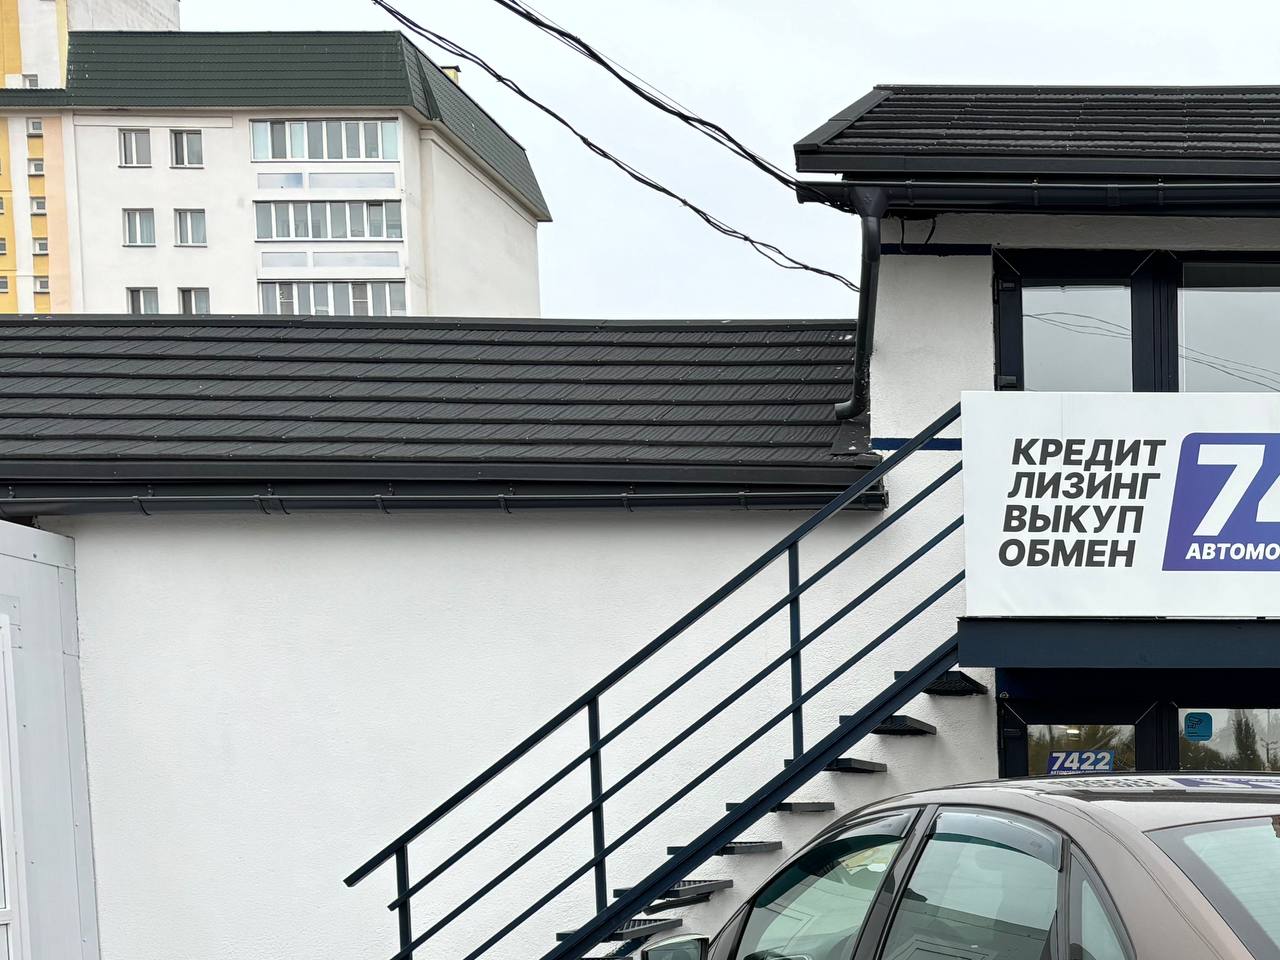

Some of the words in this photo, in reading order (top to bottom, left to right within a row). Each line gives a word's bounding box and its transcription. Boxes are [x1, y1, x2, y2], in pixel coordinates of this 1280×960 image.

[1011, 438, 1167, 470] КРЕДИТ
[1006, 472, 1161, 500] ЛИЗИНГ
[1002, 505, 1145, 533] ВЫКУП
[998, 538, 1136, 568] ОБМЕН
[1051, 751, 1111, 770] 7422
